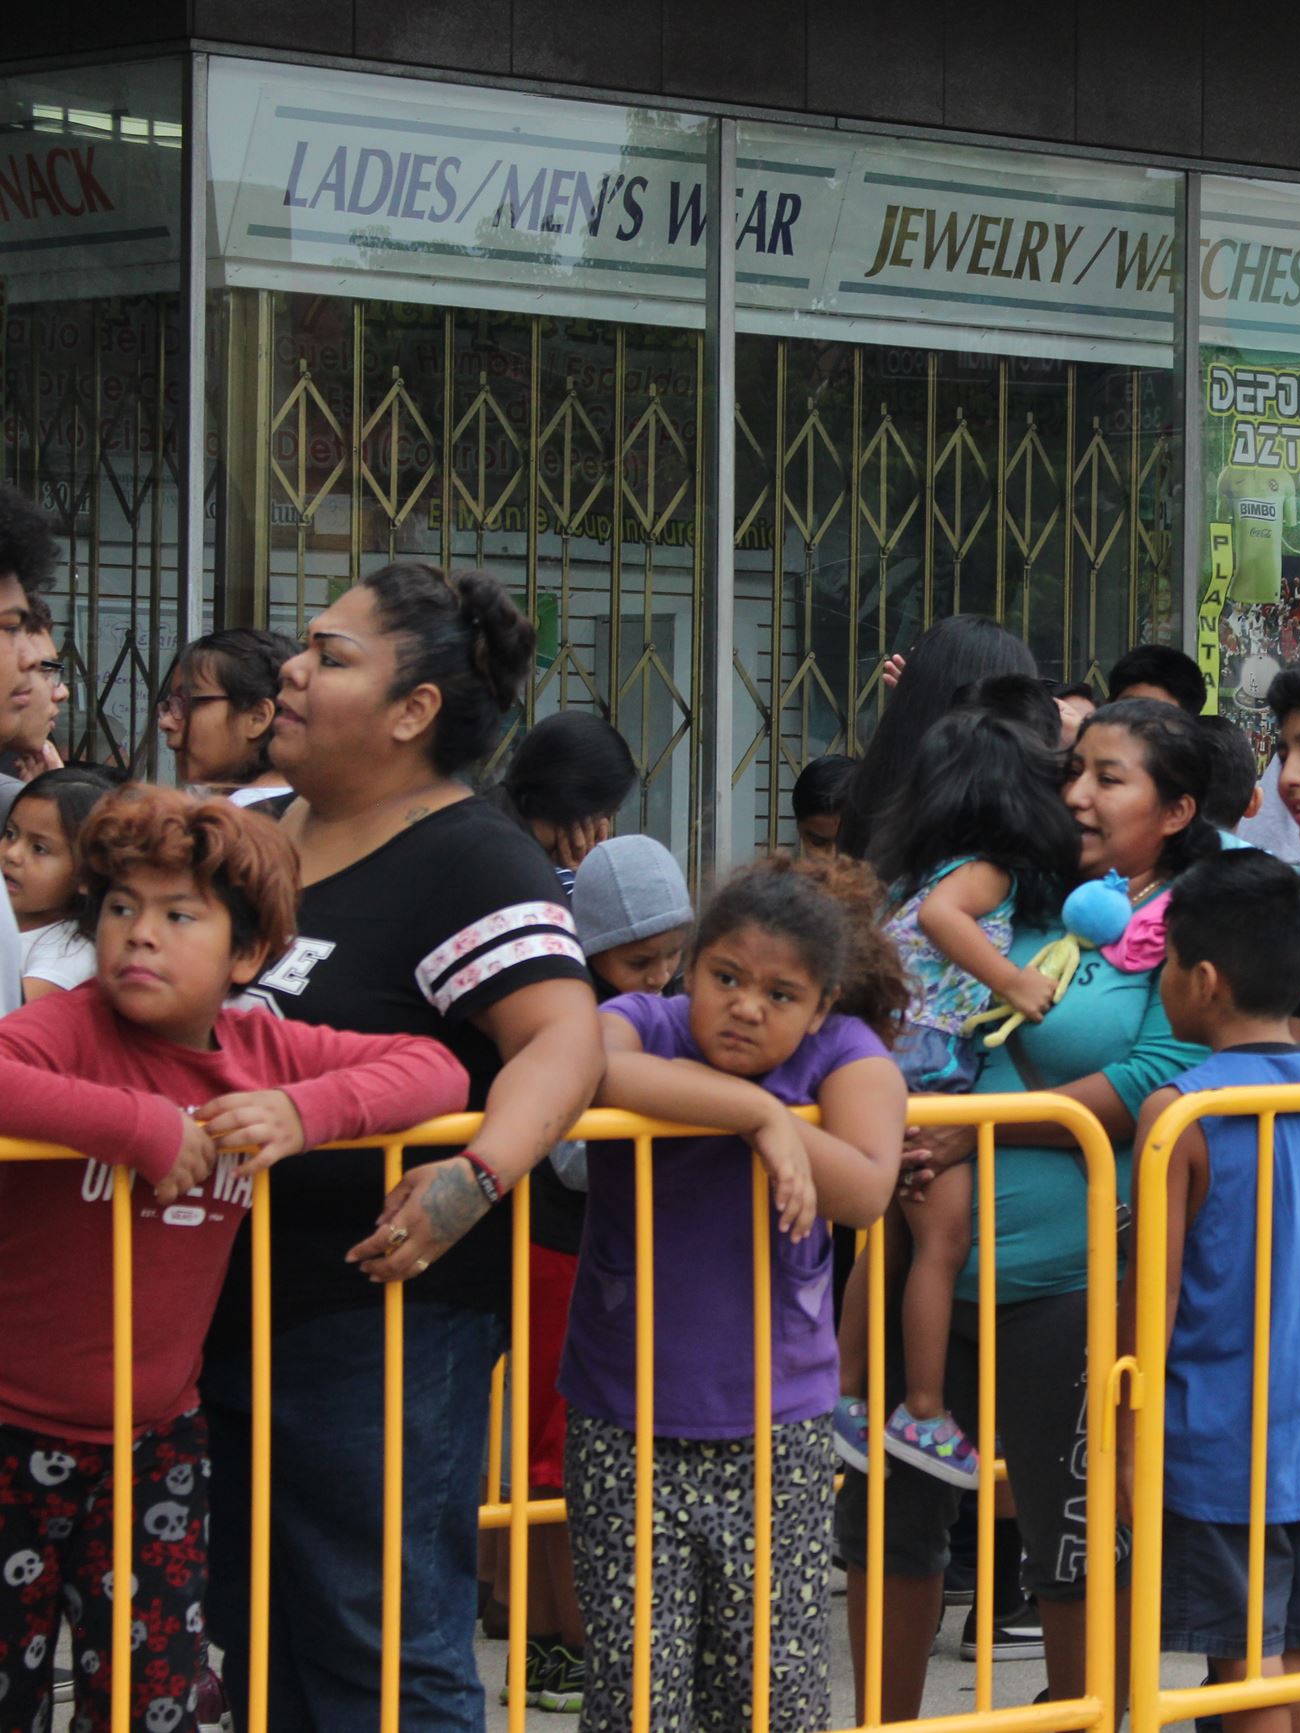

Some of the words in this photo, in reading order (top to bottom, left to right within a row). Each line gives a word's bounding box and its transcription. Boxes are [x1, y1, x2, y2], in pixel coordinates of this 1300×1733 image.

[283, 141, 649, 241] LADIES/MEN'S
[668, 181, 802, 256] WAR
[1240, 503, 1276, 517] BIMBO
